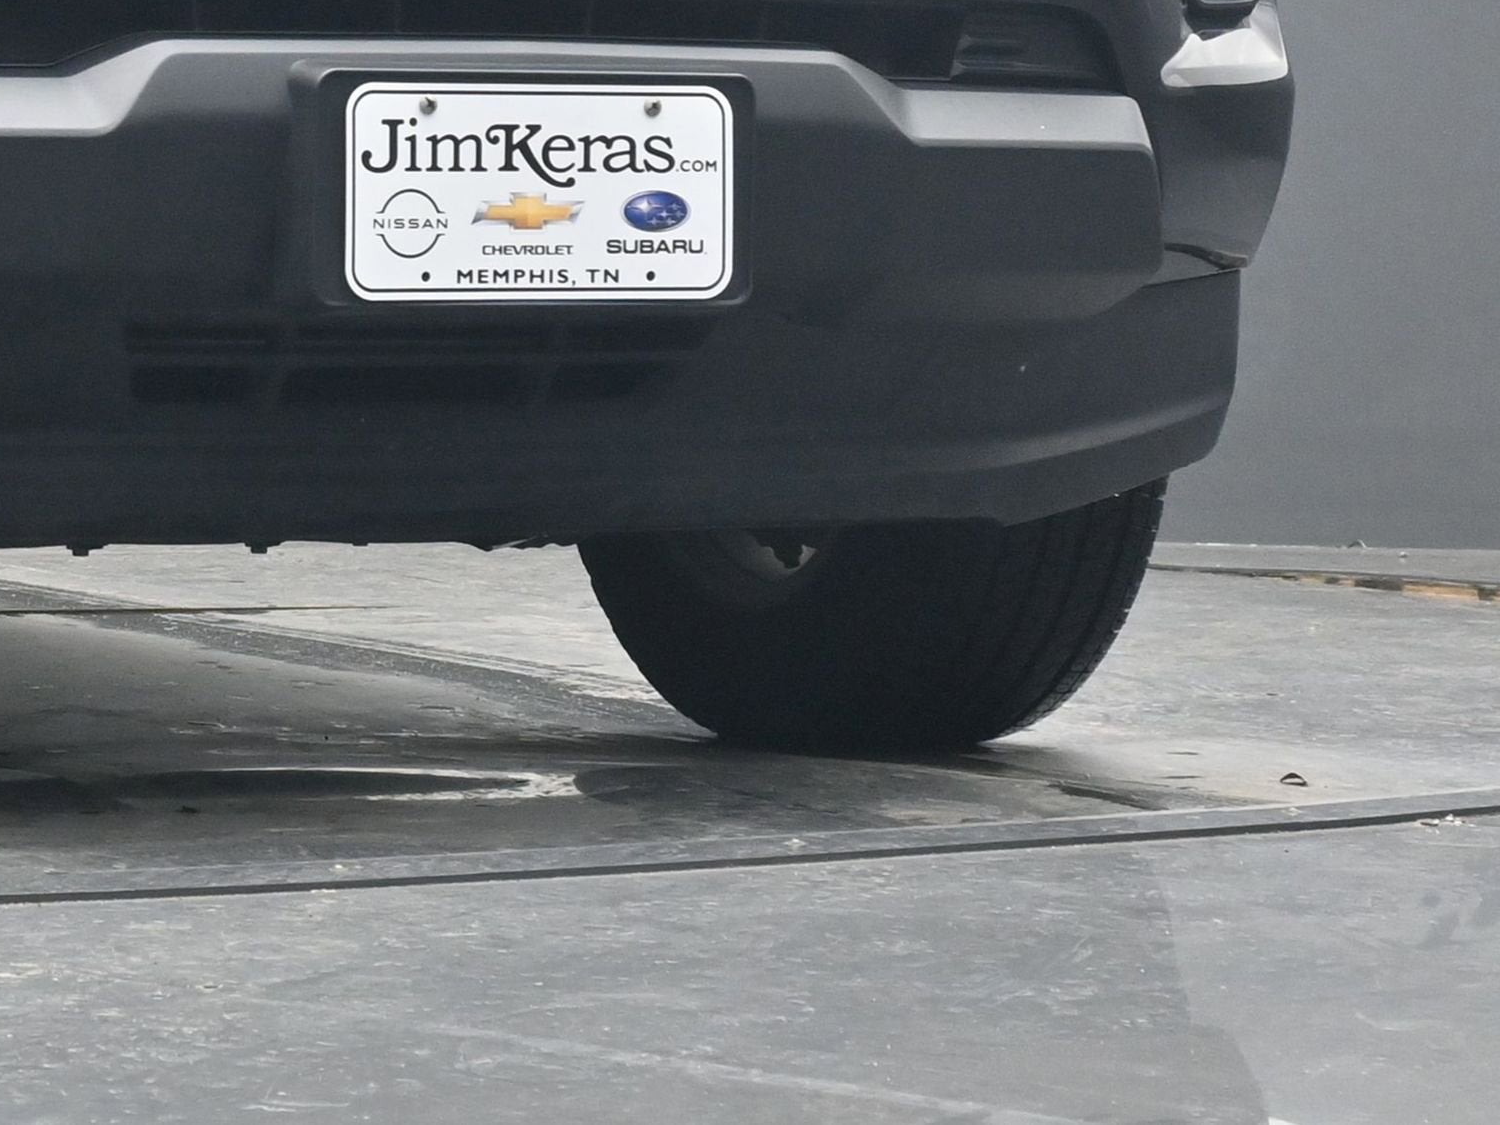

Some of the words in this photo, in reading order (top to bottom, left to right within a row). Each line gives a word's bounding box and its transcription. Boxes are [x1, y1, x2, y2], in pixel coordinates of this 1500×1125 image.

[372, 218, 449, 230] NISSAN
[481, 244, 574, 256] CHEVROLET
[606, 239, 705, 255] SUBARU
[456, 268, 576, 286] MEMPHIS,
[585, 268, 620, 284] TN
